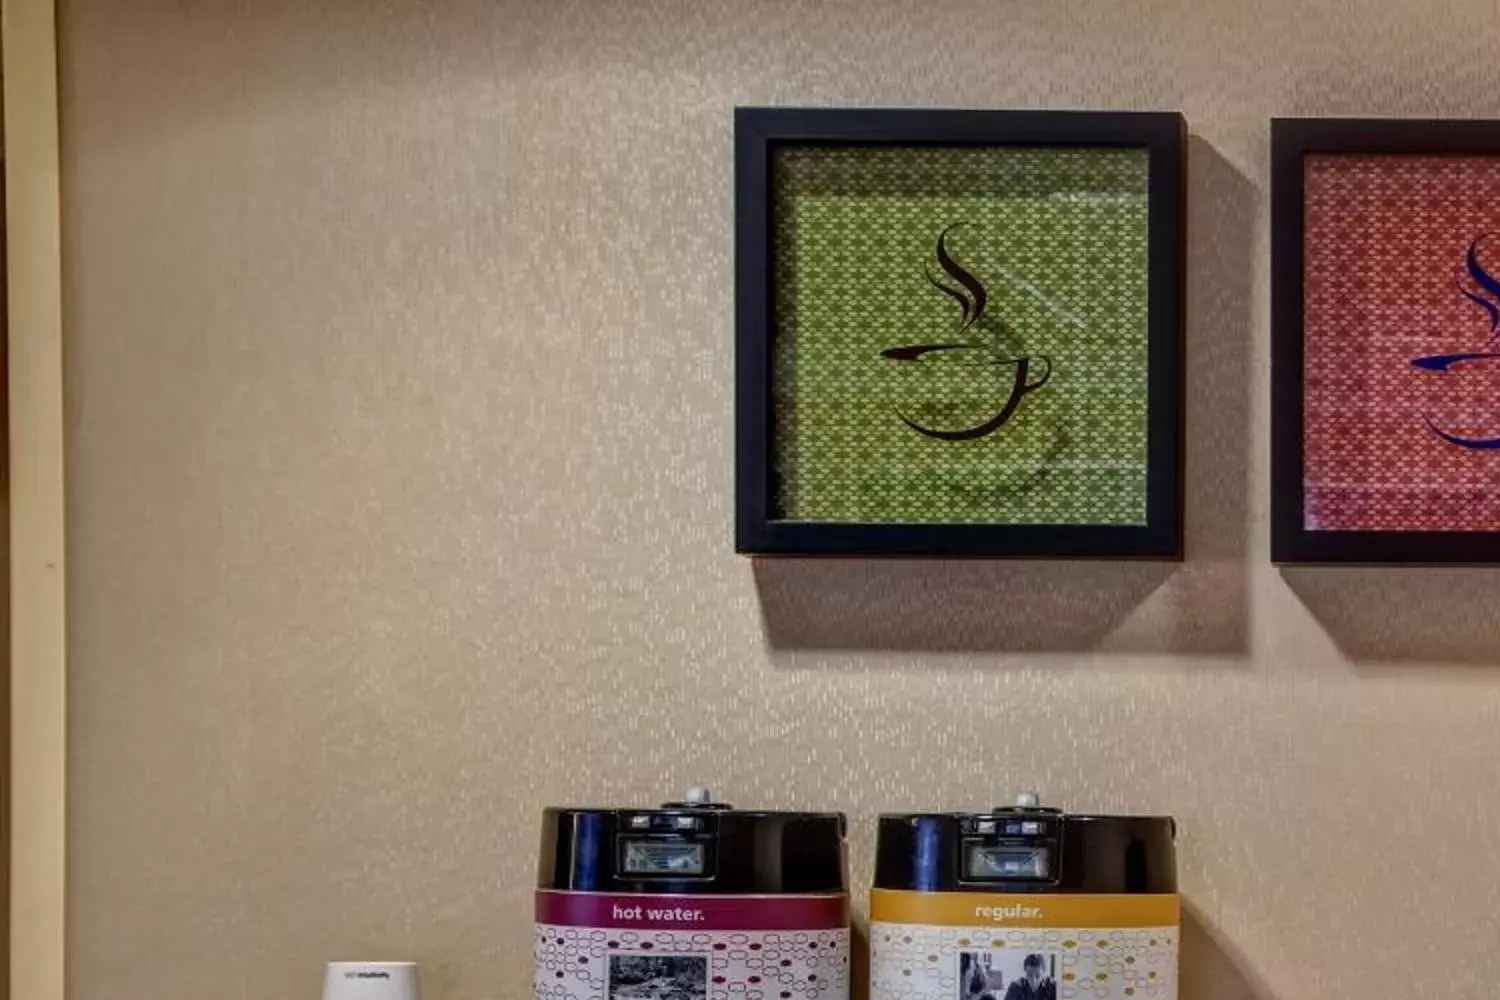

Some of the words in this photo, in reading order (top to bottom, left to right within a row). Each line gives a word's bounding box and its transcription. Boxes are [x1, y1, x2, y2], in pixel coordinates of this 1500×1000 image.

[612, 904, 642, 920] hot
[646, 906, 705, 921] water.
[975, 903, 1045, 921] regular.
